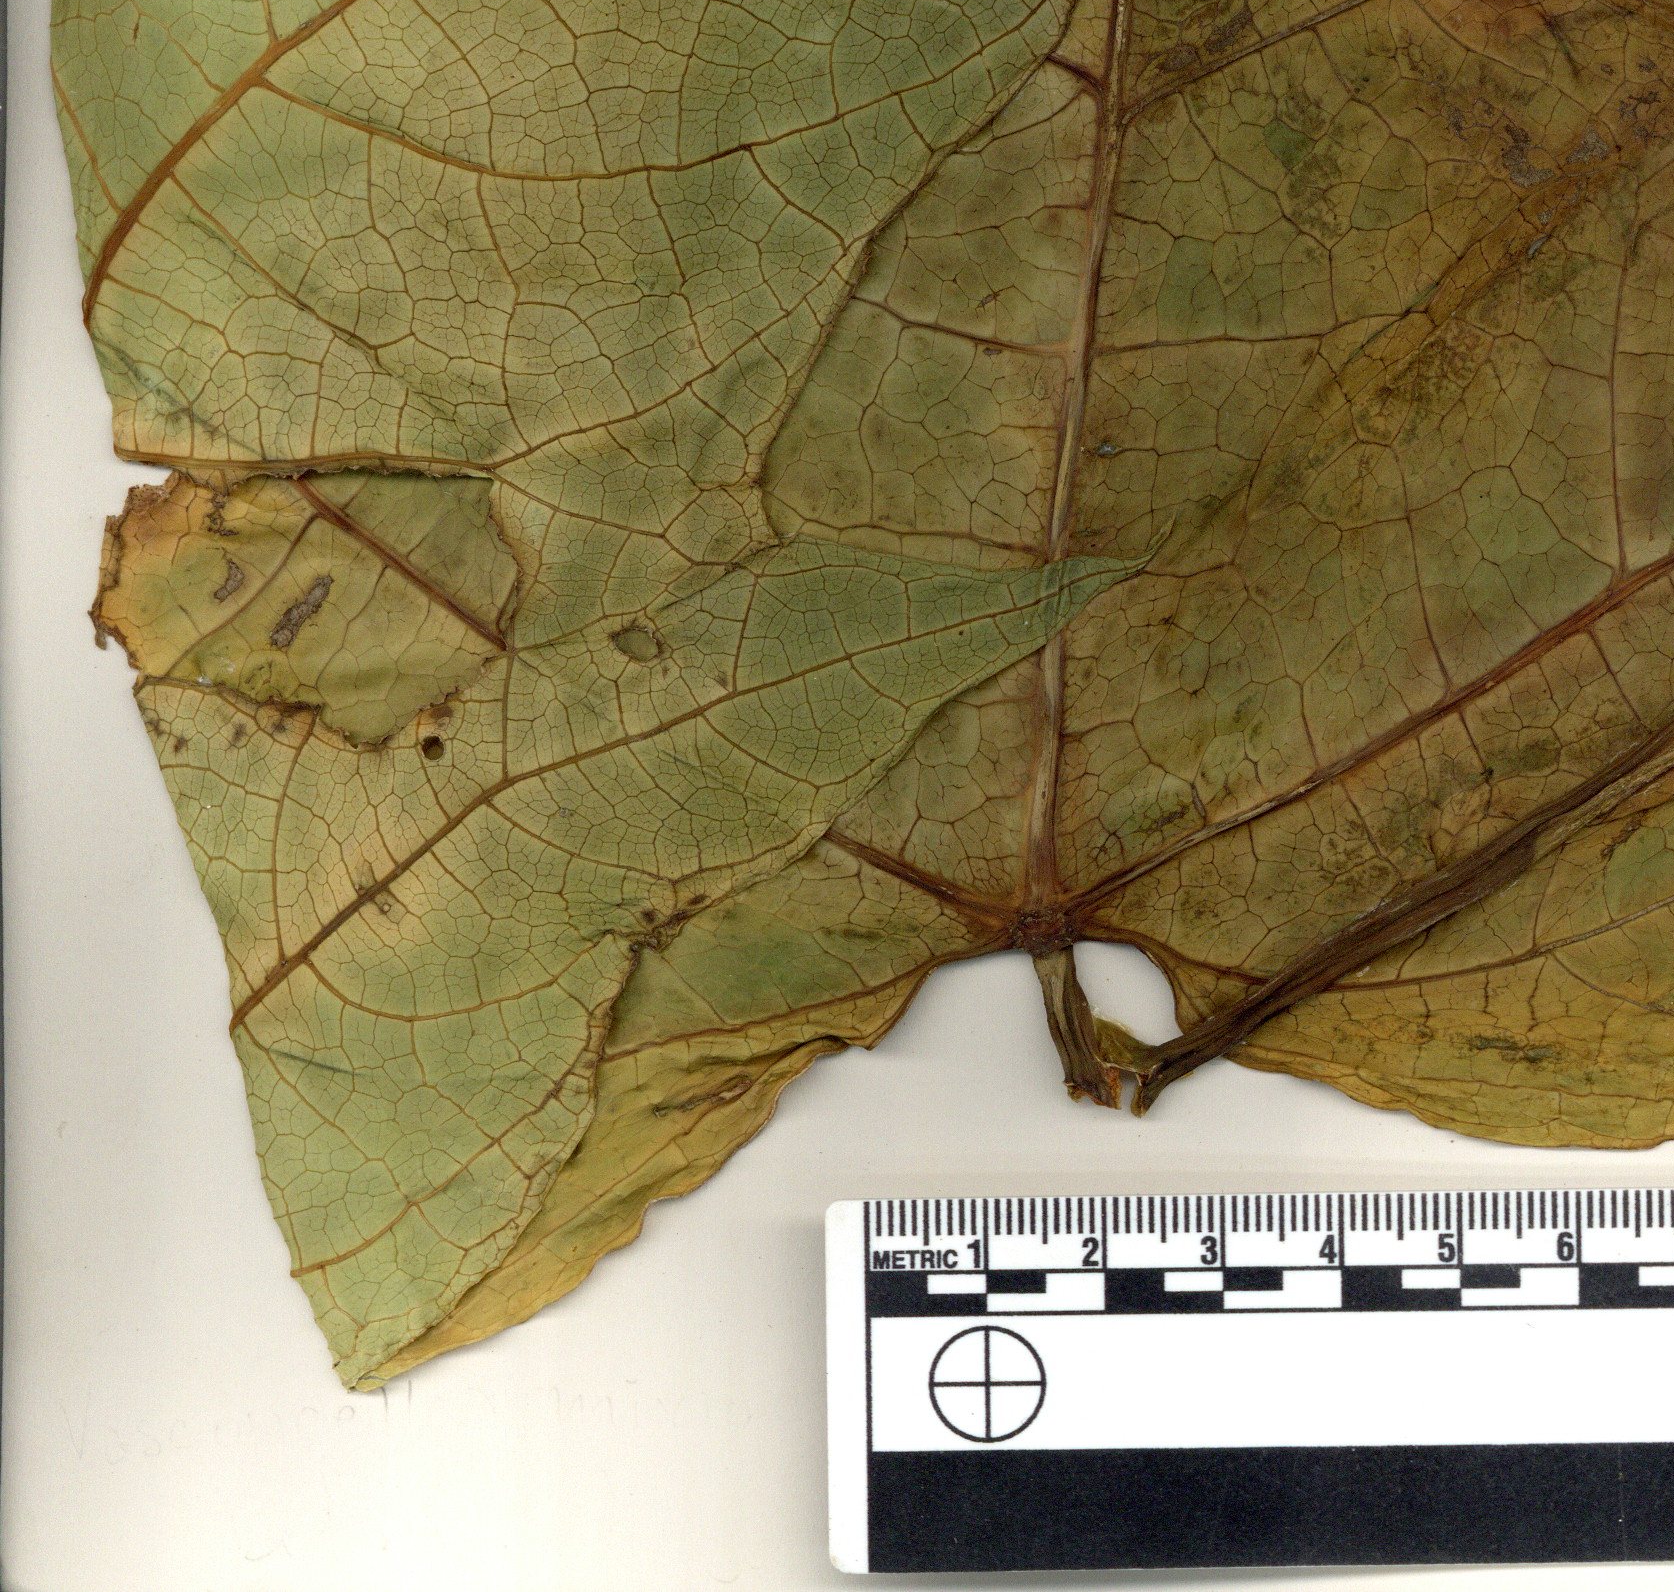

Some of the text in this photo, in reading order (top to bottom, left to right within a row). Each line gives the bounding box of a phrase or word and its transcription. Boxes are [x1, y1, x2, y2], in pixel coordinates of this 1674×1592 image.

[874, 1249, 959, 1269] METRIC
[967, 1239, 981, 1269] 1
[1082, 1237, 1099, 1267] 2
[1200, 1236, 1218, 1266] 3
[1319, 1234, 1338, 1264] 4
[1438, 1233, 1456, 1263] 5
[1557, 1232, 1575, 1262] 6
